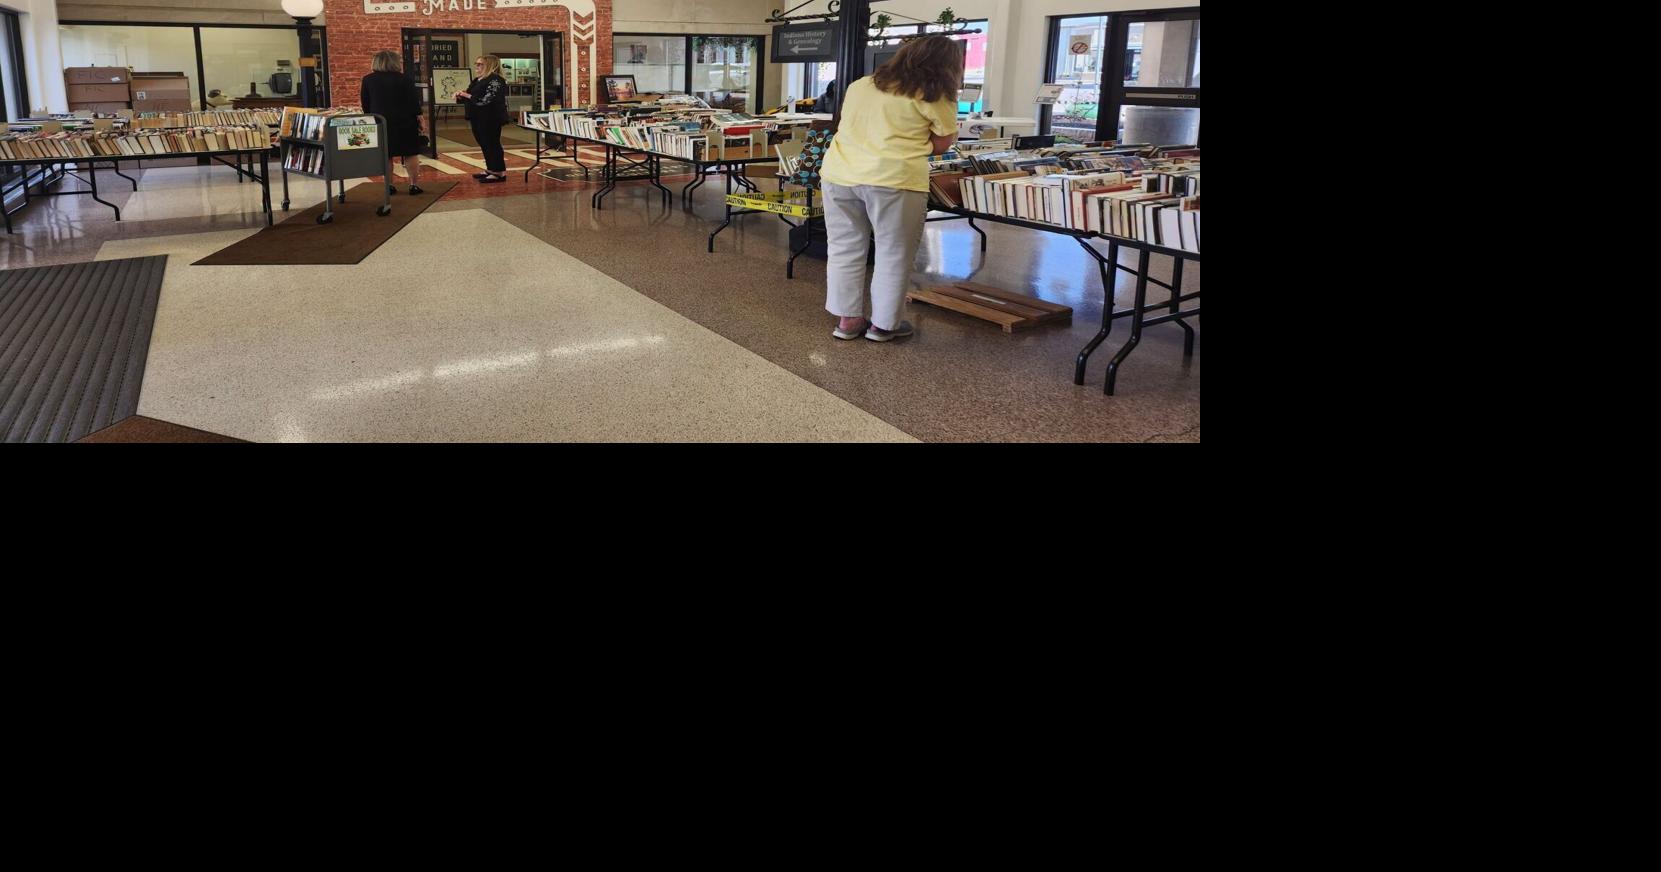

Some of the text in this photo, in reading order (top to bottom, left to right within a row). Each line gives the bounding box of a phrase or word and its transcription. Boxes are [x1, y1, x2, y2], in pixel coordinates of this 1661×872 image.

[422, 0, 487, 15] MADE
[768, 202, 792, 213] CAUTION
[801, 207, 824, 216] CAUTIO
